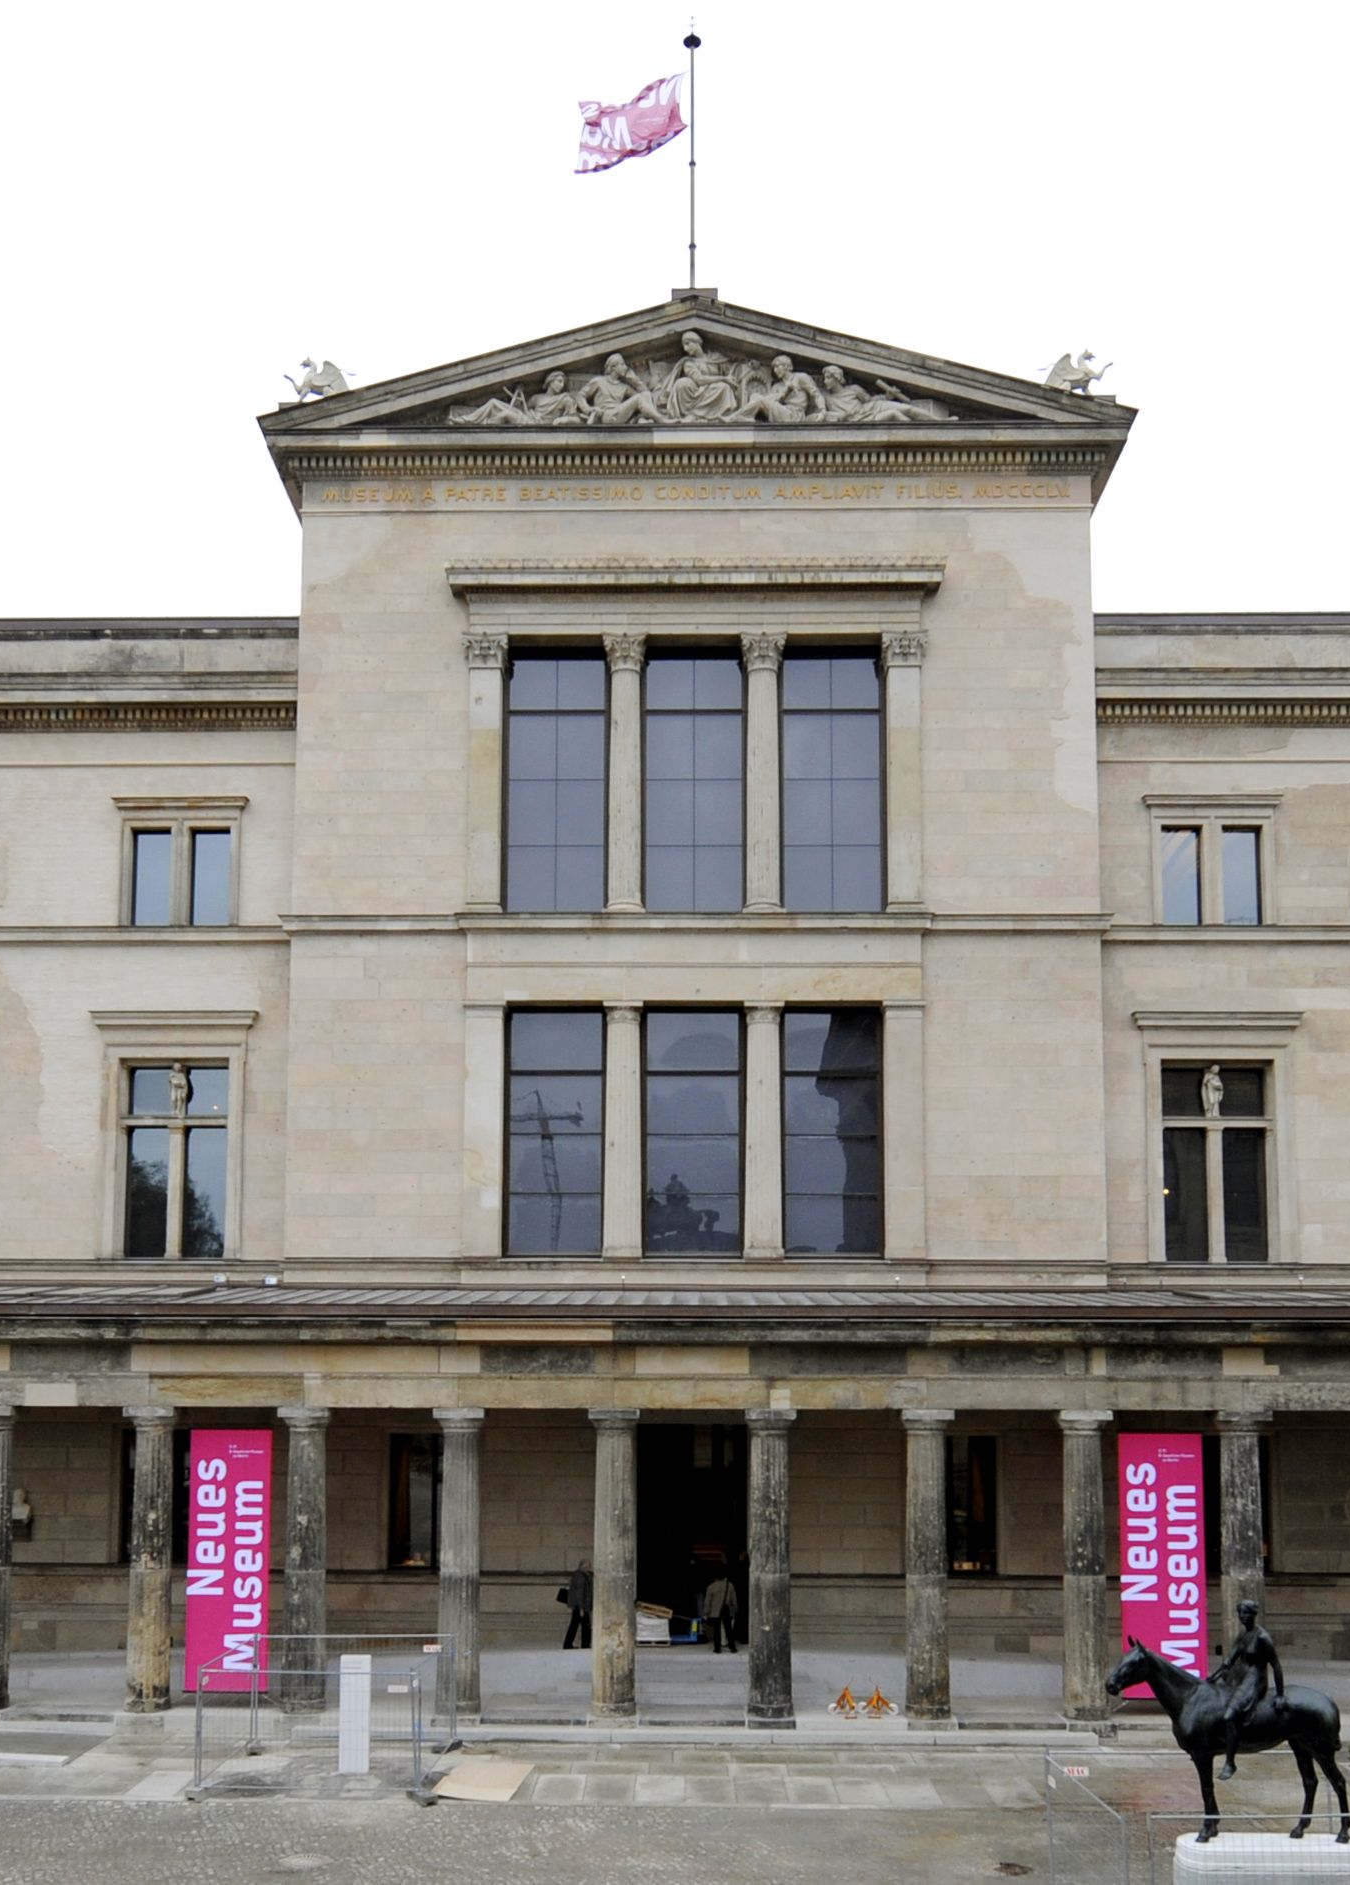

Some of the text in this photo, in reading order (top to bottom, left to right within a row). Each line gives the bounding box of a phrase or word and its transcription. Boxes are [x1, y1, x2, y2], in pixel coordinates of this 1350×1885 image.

[421, 487, 437, 502] A
[444, 486, 507, 502] PATRE
[519, 485, 644, 501] BEATISSIMO
[773, 483, 885, 500] AMPLIAVIT
[186, 1458, 227, 1596] Neues
[222, 1480, 264, 1671] Museum
[1120, 1462, 1158, 1602] Neues
[1160, 1484, 1200, 1679] Museum
